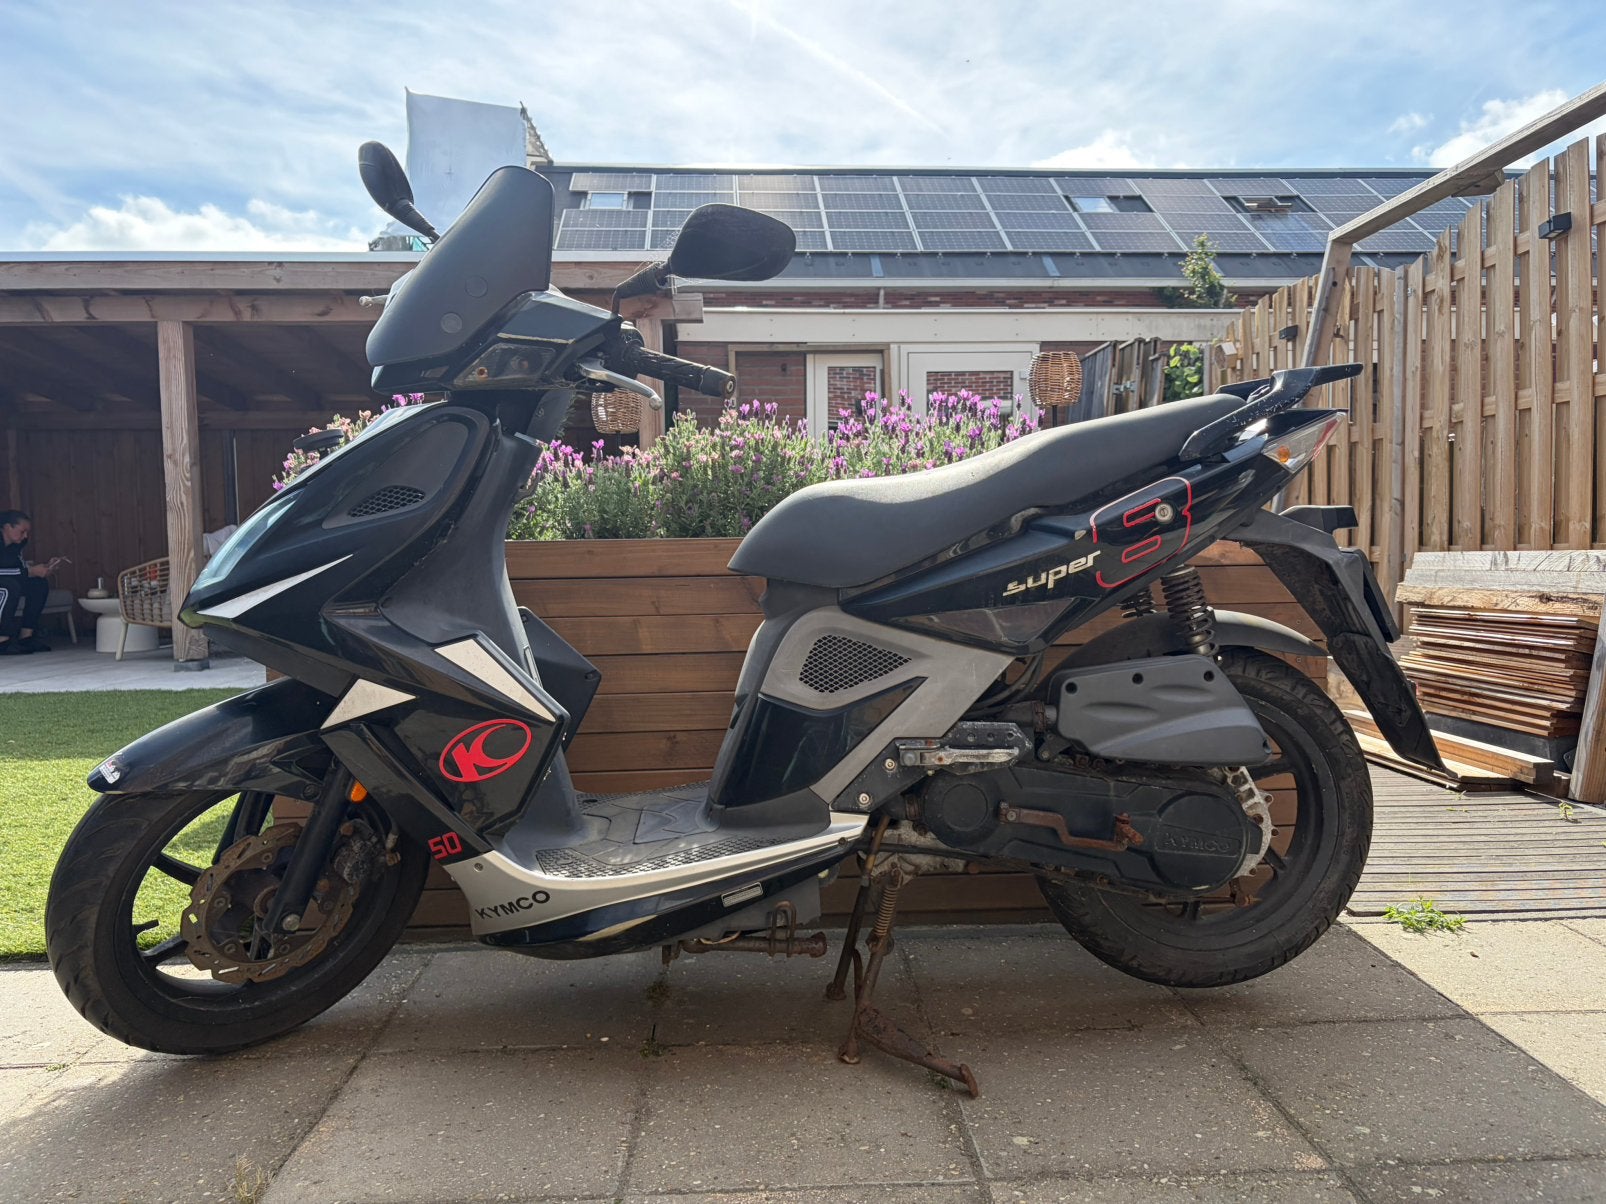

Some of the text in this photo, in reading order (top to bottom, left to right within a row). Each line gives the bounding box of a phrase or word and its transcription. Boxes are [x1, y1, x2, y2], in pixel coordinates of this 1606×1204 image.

[1003, 550, 1101, 597] super
[428, 831, 462, 859] 50
[475, 889, 551, 920] KYMCO
